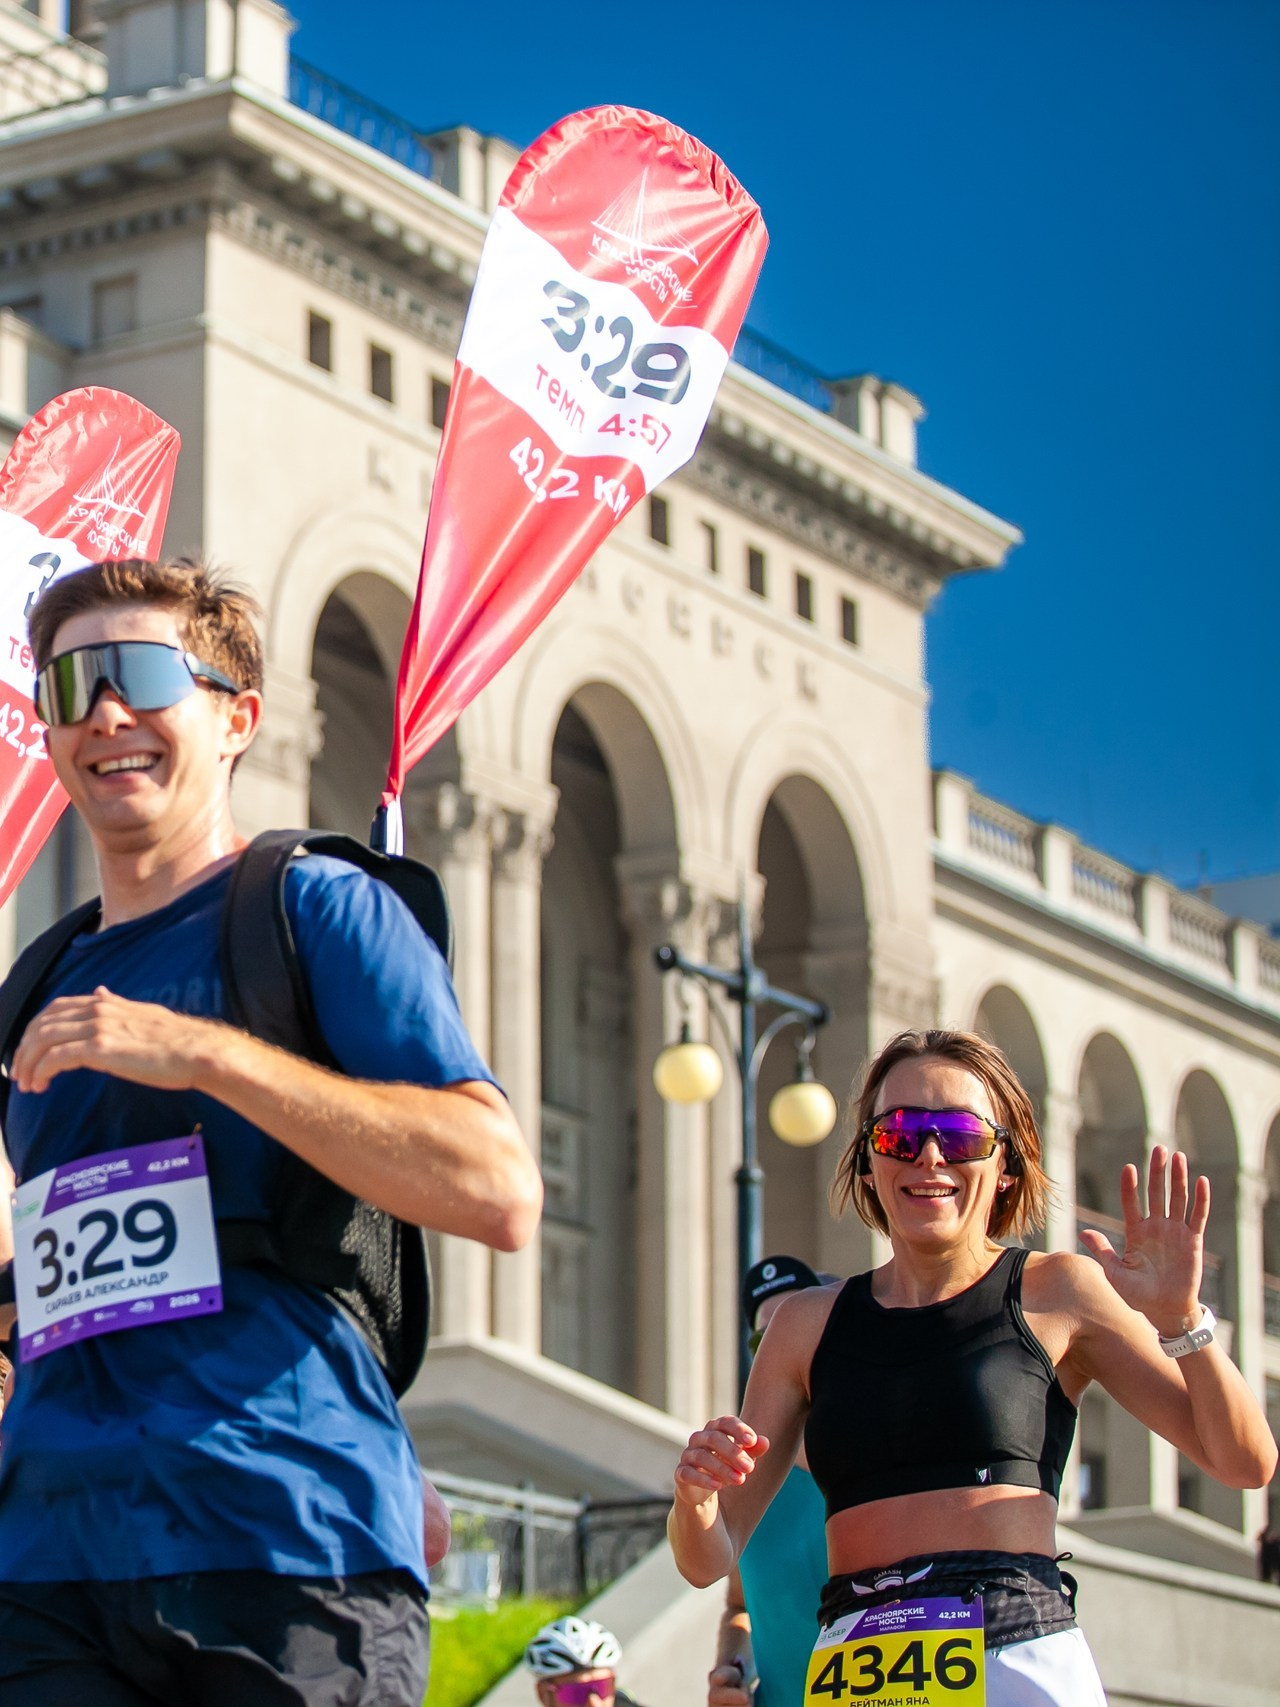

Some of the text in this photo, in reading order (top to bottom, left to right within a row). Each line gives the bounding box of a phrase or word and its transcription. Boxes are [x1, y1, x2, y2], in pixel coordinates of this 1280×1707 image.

[591, 233, 693, 302] КРАСНОЯРСКИЕ
[625, 265, 669, 303] МОСТЫ
[540, 280, 692, 405] 3:29
[598, 412, 672, 454] 4:57
[509, 436, 580, 502] 42,2
[87, 529, 121, 557] ОСТЫ
[33, 1198, 179, 1299] 3:29
[84, 1271, 170, 1302] АЛЕКСАНДР
[864, 1606, 926, 1624] КРАСНОЯРСКИЕ
[878, 1615, 908, 1627] МОСТЫ
[938, 1610, 971, 1620] 42,2 КМ
[826, 1627, 848, 1641] СБЕР
[810, 1637, 978, 1700] 4346
[904, 1695, 930, 1707] ЯНА
